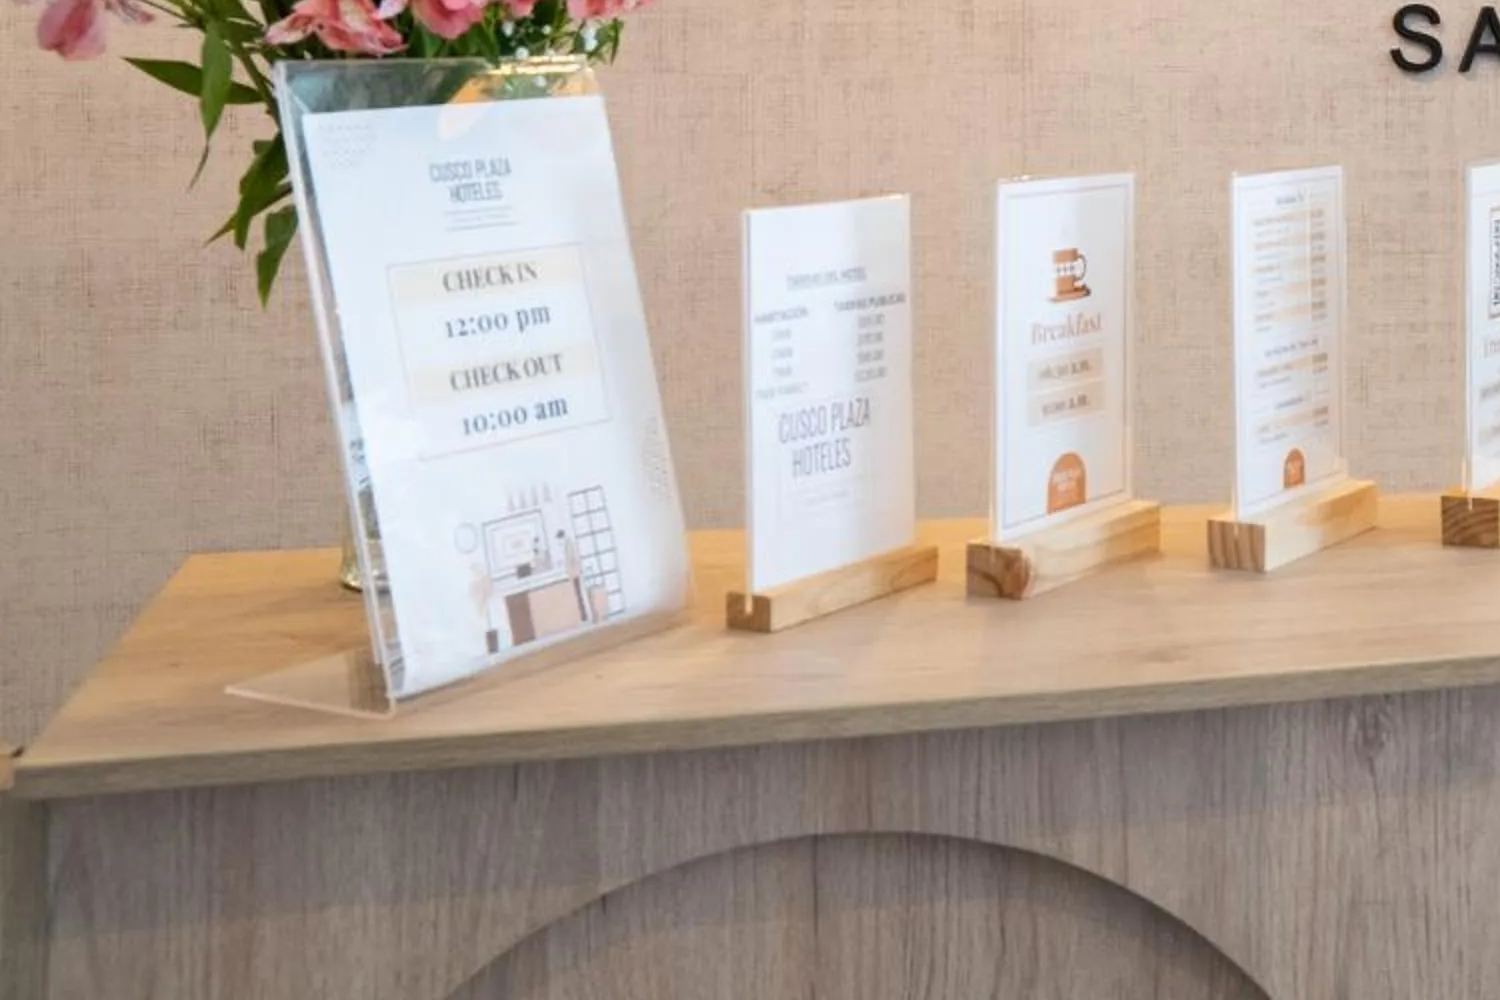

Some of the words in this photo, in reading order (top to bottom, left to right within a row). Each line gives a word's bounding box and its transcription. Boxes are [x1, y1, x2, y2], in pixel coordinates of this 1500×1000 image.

[442, 264, 514, 293] CHECK
[516, 260, 539, 284] IN
[444, 312, 509, 340] 12:00
[515, 305, 551, 334] pm
[449, 360, 522, 393] CHECK
[523, 352, 564, 379] OUT
[462, 404, 528, 437] 10:00
[534, 397, 569, 422] am
[778, 405, 828, 444] CUSCO
[830, 395, 871, 433] PLAZA
[791, 436, 852, 479] HOTELES
